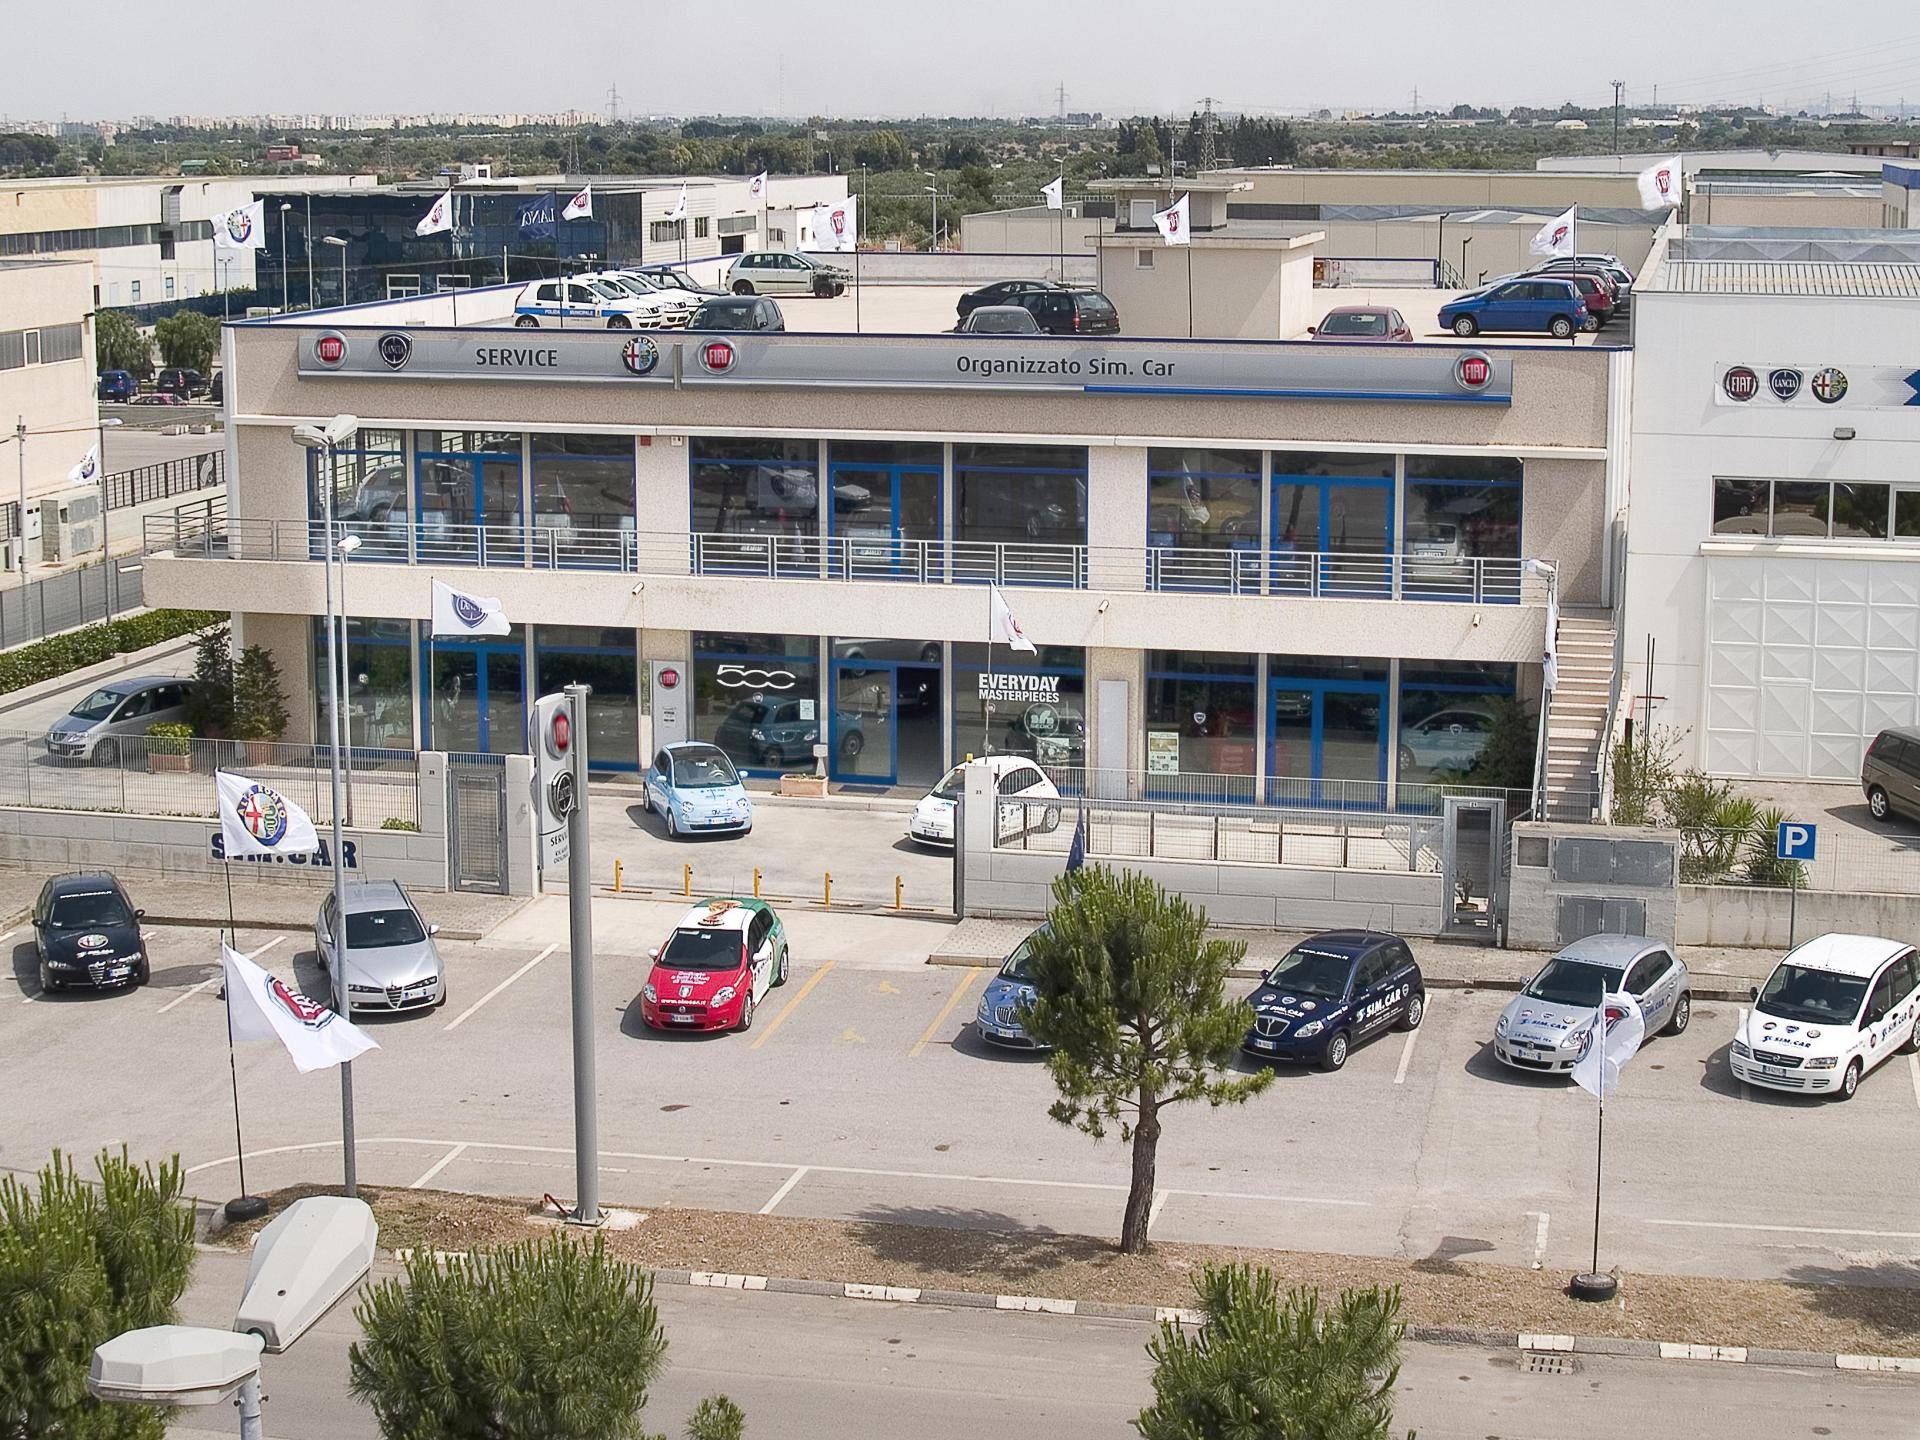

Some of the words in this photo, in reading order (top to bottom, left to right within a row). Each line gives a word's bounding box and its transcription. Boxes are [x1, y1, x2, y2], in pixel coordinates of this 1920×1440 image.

[322, 342, 340, 357] FIAT
[476, 348, 557, 366] SERVICE
[709, 349, 729, 364] FIAT
[957, 356, 1081, 377] Organizzato
[1088, 358, 1134, 376] Sim.
[1142, 360, 1175, 376] Car
[1465, 363, 1485, 380] FIAT
[1731, 376, 1752, 392] FIAT
[1774, 378, 1796, 389] LANCIA
[716, 664, 796, 689] 500
[978, 673, 1060, 692] EVERYDAY
[978, 688, 1060, 703] MASTERPIECES
[1785, 826, 1809, 855] P
[1366, 988, 1401, 1018] SIM.CAR
[1775, 1036, 1811, 1048] SIM.CAR
